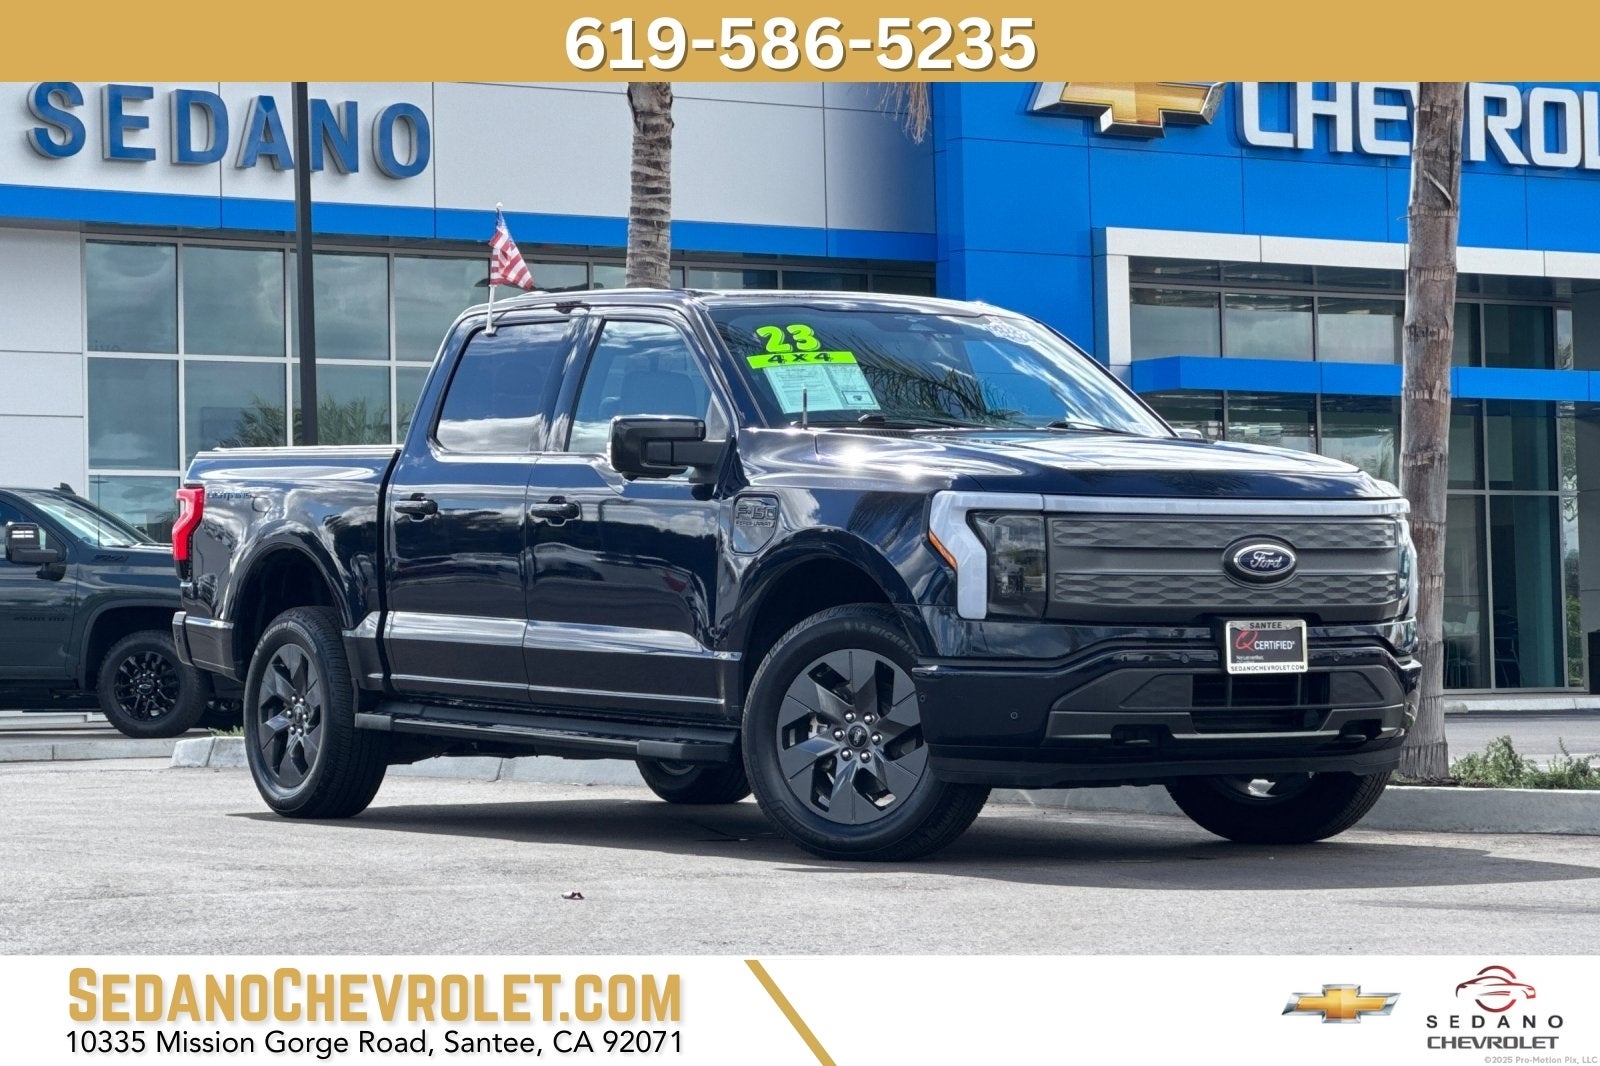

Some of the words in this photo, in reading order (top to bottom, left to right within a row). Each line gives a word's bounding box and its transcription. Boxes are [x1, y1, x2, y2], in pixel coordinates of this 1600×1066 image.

[27, 82, 431, 180] SEDANO
[755, 324, 821, 353] 23
[1250, 551, 1282, 568] Ford
[1230, 664, 1305, 672] SEDANOCHEVROLET.COM
